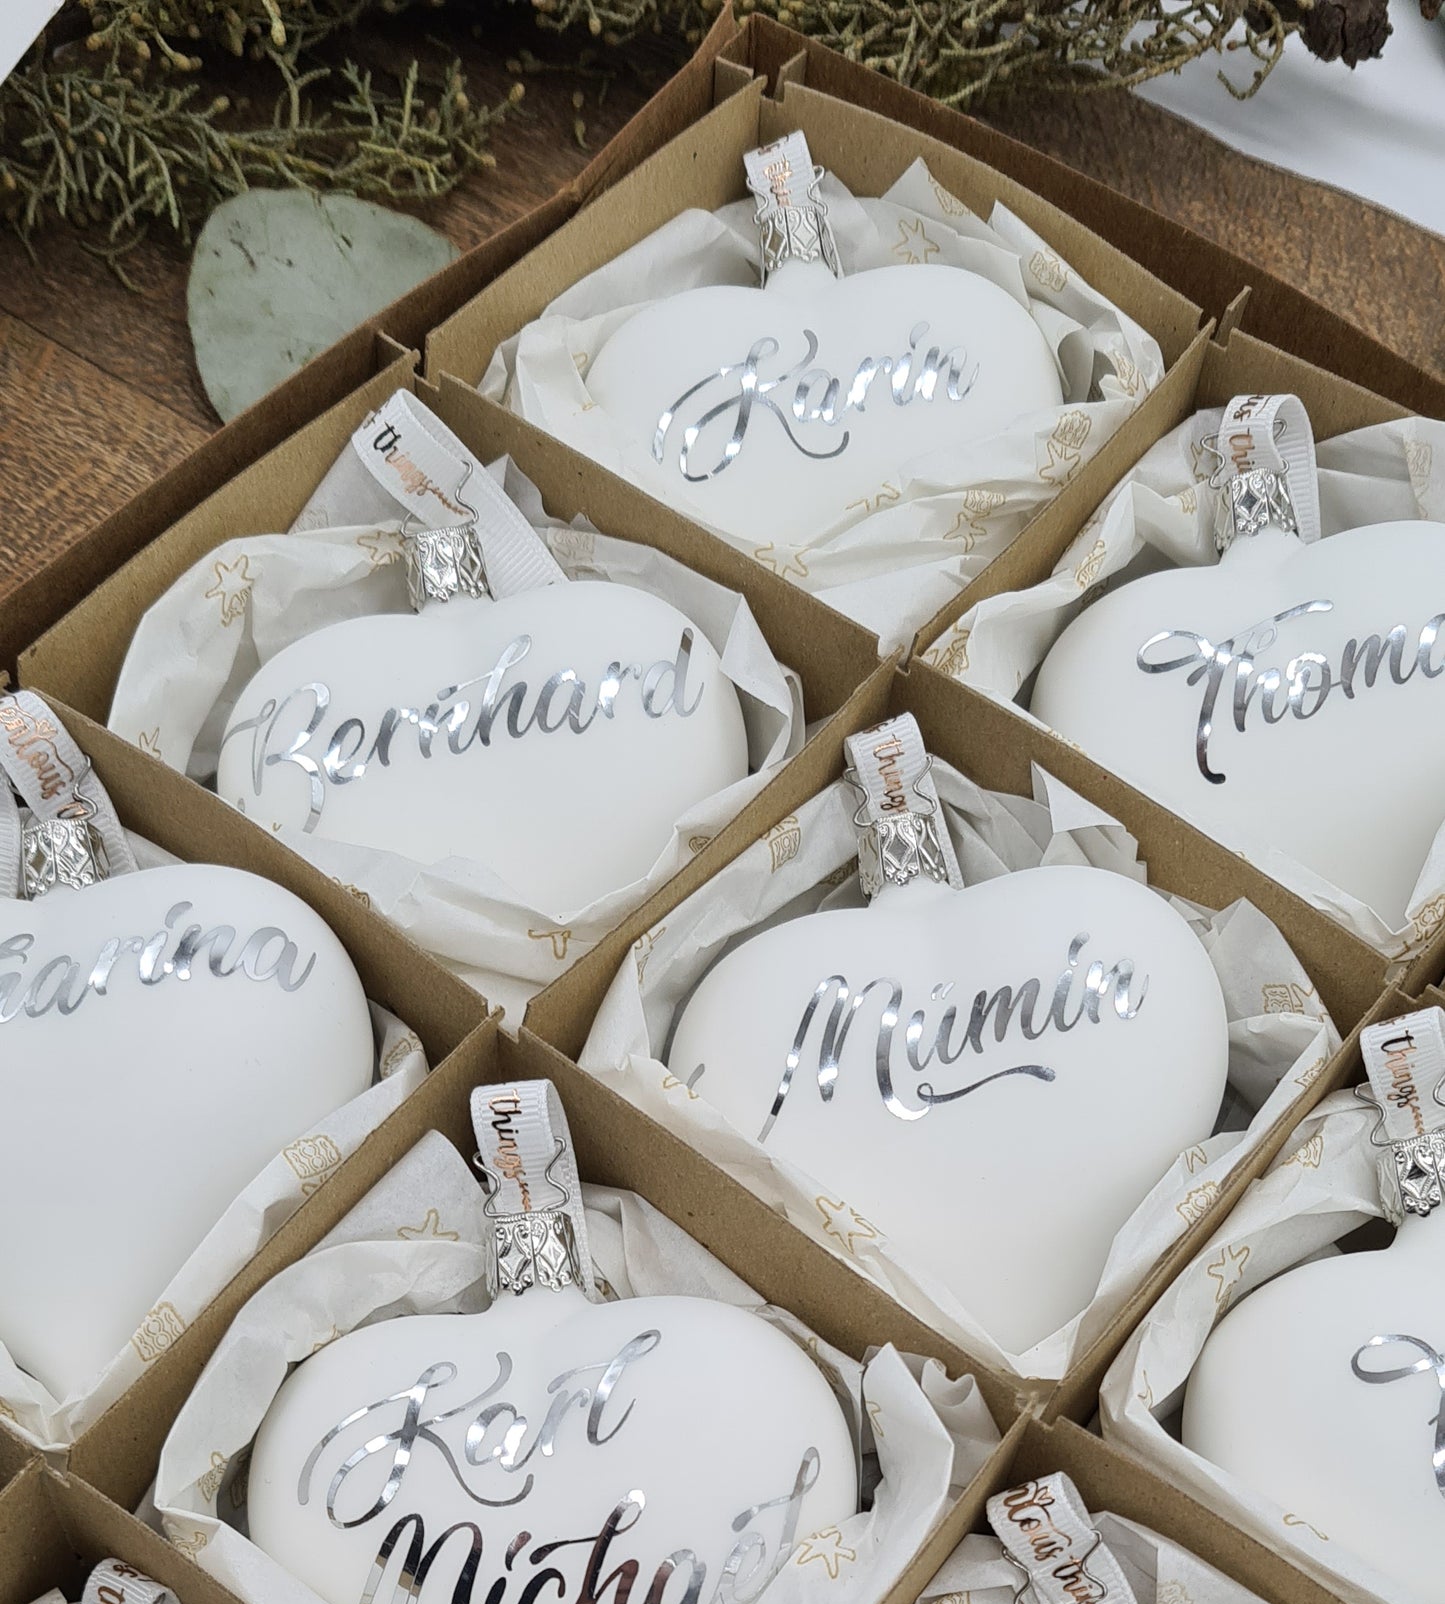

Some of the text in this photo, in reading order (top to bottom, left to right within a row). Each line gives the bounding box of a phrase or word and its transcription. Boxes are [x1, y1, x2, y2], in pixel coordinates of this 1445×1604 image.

[651, 321, 981, 483] Karin
[221, 627, 705, 835] Bernhard
[297, 1329, 662, 1529] Karl
